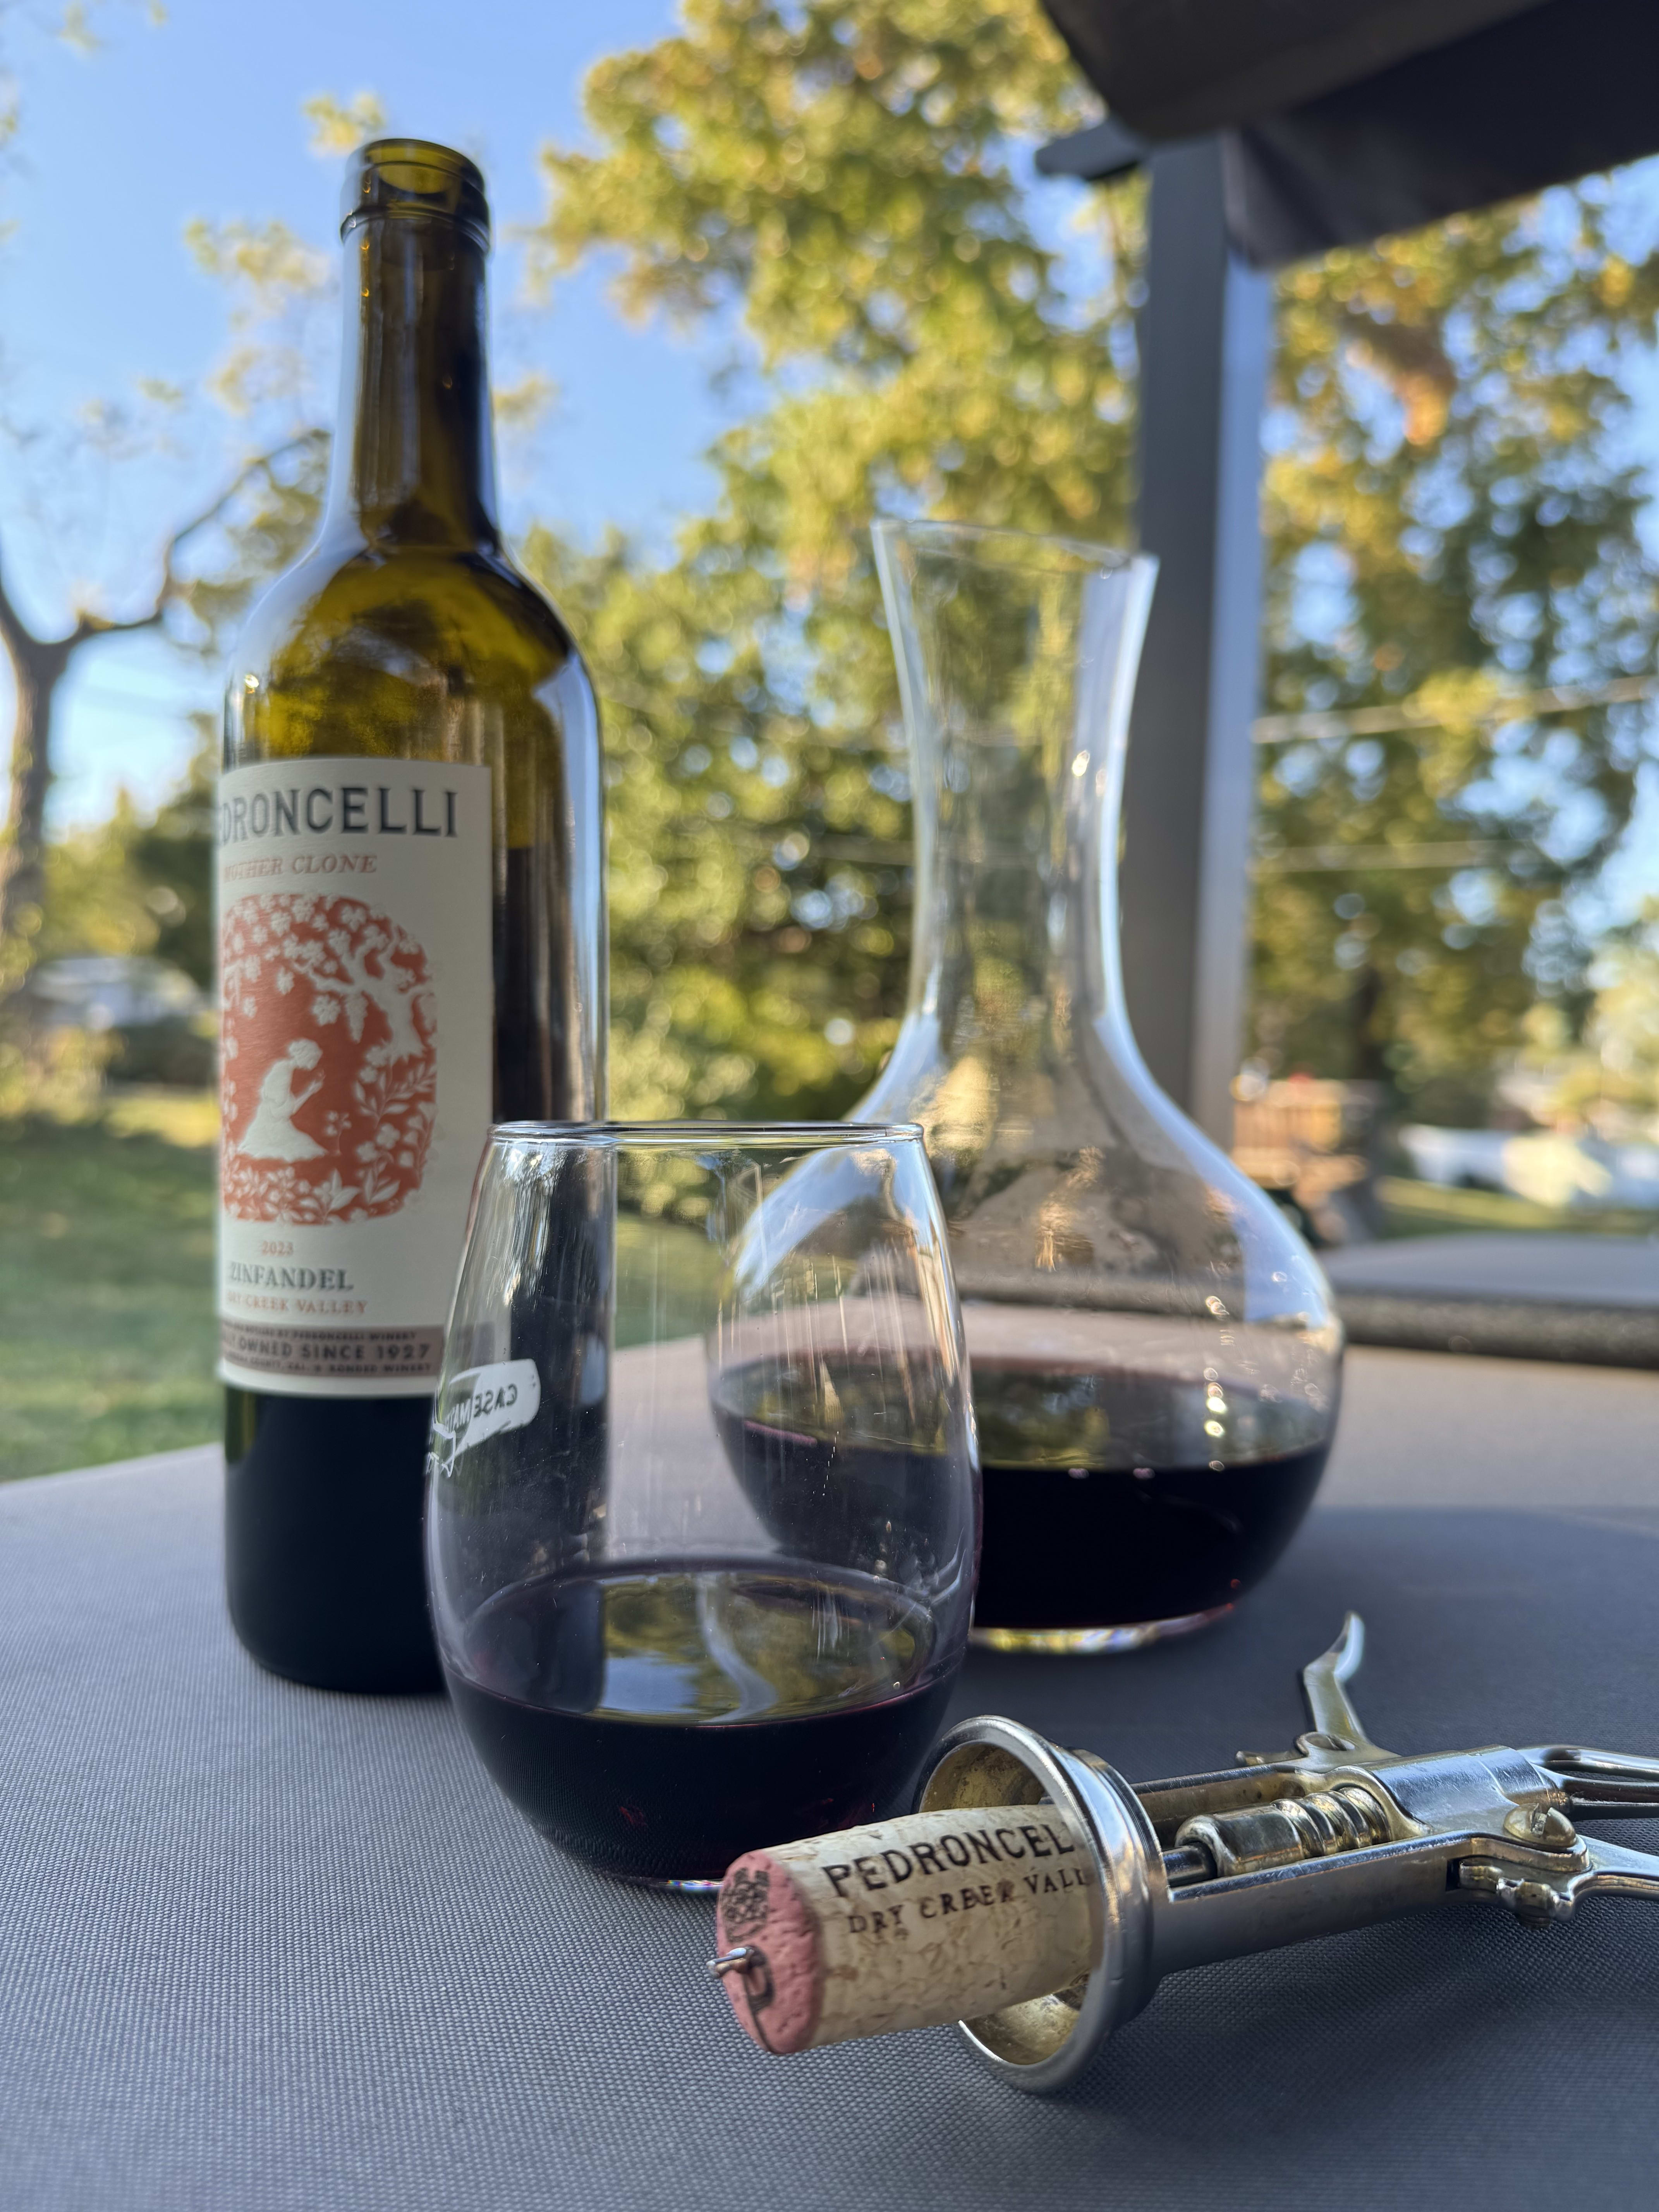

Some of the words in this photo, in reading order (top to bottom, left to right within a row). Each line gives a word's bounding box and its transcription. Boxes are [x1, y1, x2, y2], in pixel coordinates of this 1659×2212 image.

[220, 786, 458, 847] DRONCELLI
[291, 854, 378, 874] CLONE
[231, 1261, 354, 1291] ZINFANDEL
[295, 1298, 368, 1314] VALLEY
[239, 1336, 292, 1357] OWNED
[302, 1344, 364, 1360] SINCE
[377, 1343, 431, 1360] 1927
[821, 1821, 1075, 1898] PEDRONCEL
[847, 1904, 904, 1934] DRY
[1023, 1867, 1091, 1894] VALL
